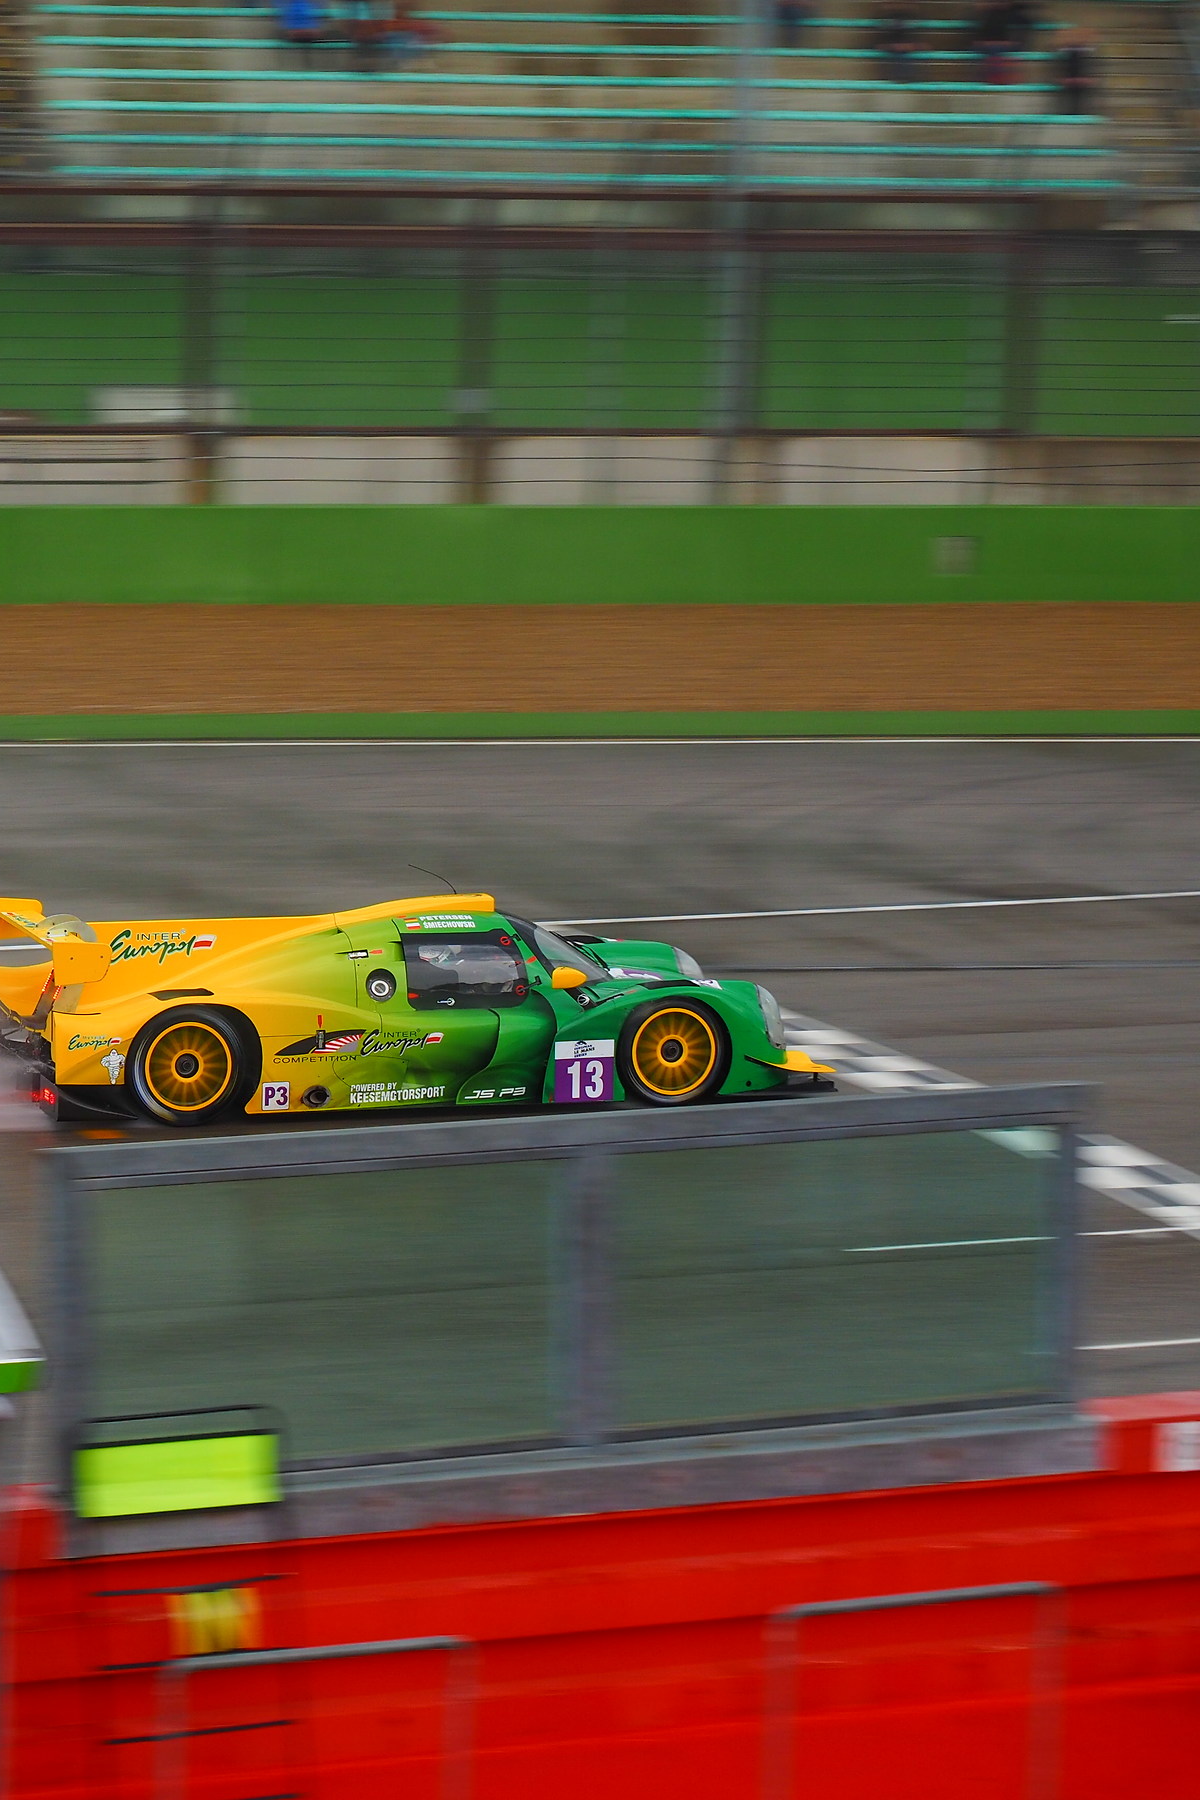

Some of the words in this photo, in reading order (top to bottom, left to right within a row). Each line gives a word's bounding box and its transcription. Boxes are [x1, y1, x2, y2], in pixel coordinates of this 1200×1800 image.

[136, 932, 181, 941] INTER
[109, 929, 197, 964] Europol
[68, 1034, 112, 1051] Europol
[383, 1030, 417, 1038] INTER
[360, 1029, 429, 1057] Europol
[272, 1055, 357, 1064] COMPETITION
[350, 1083, 385, 1092] POWERED
[387, 1082, 397, 1090] BY
[567, 1060, 604, 1099] 13
[264, 1086, 288, 1107] P3
[350, 1086, 446, 1104] KEESEMOTORSPORT
[464, 1089, 496, 1100] JS
[498, 1086, 527, 1098] P3
